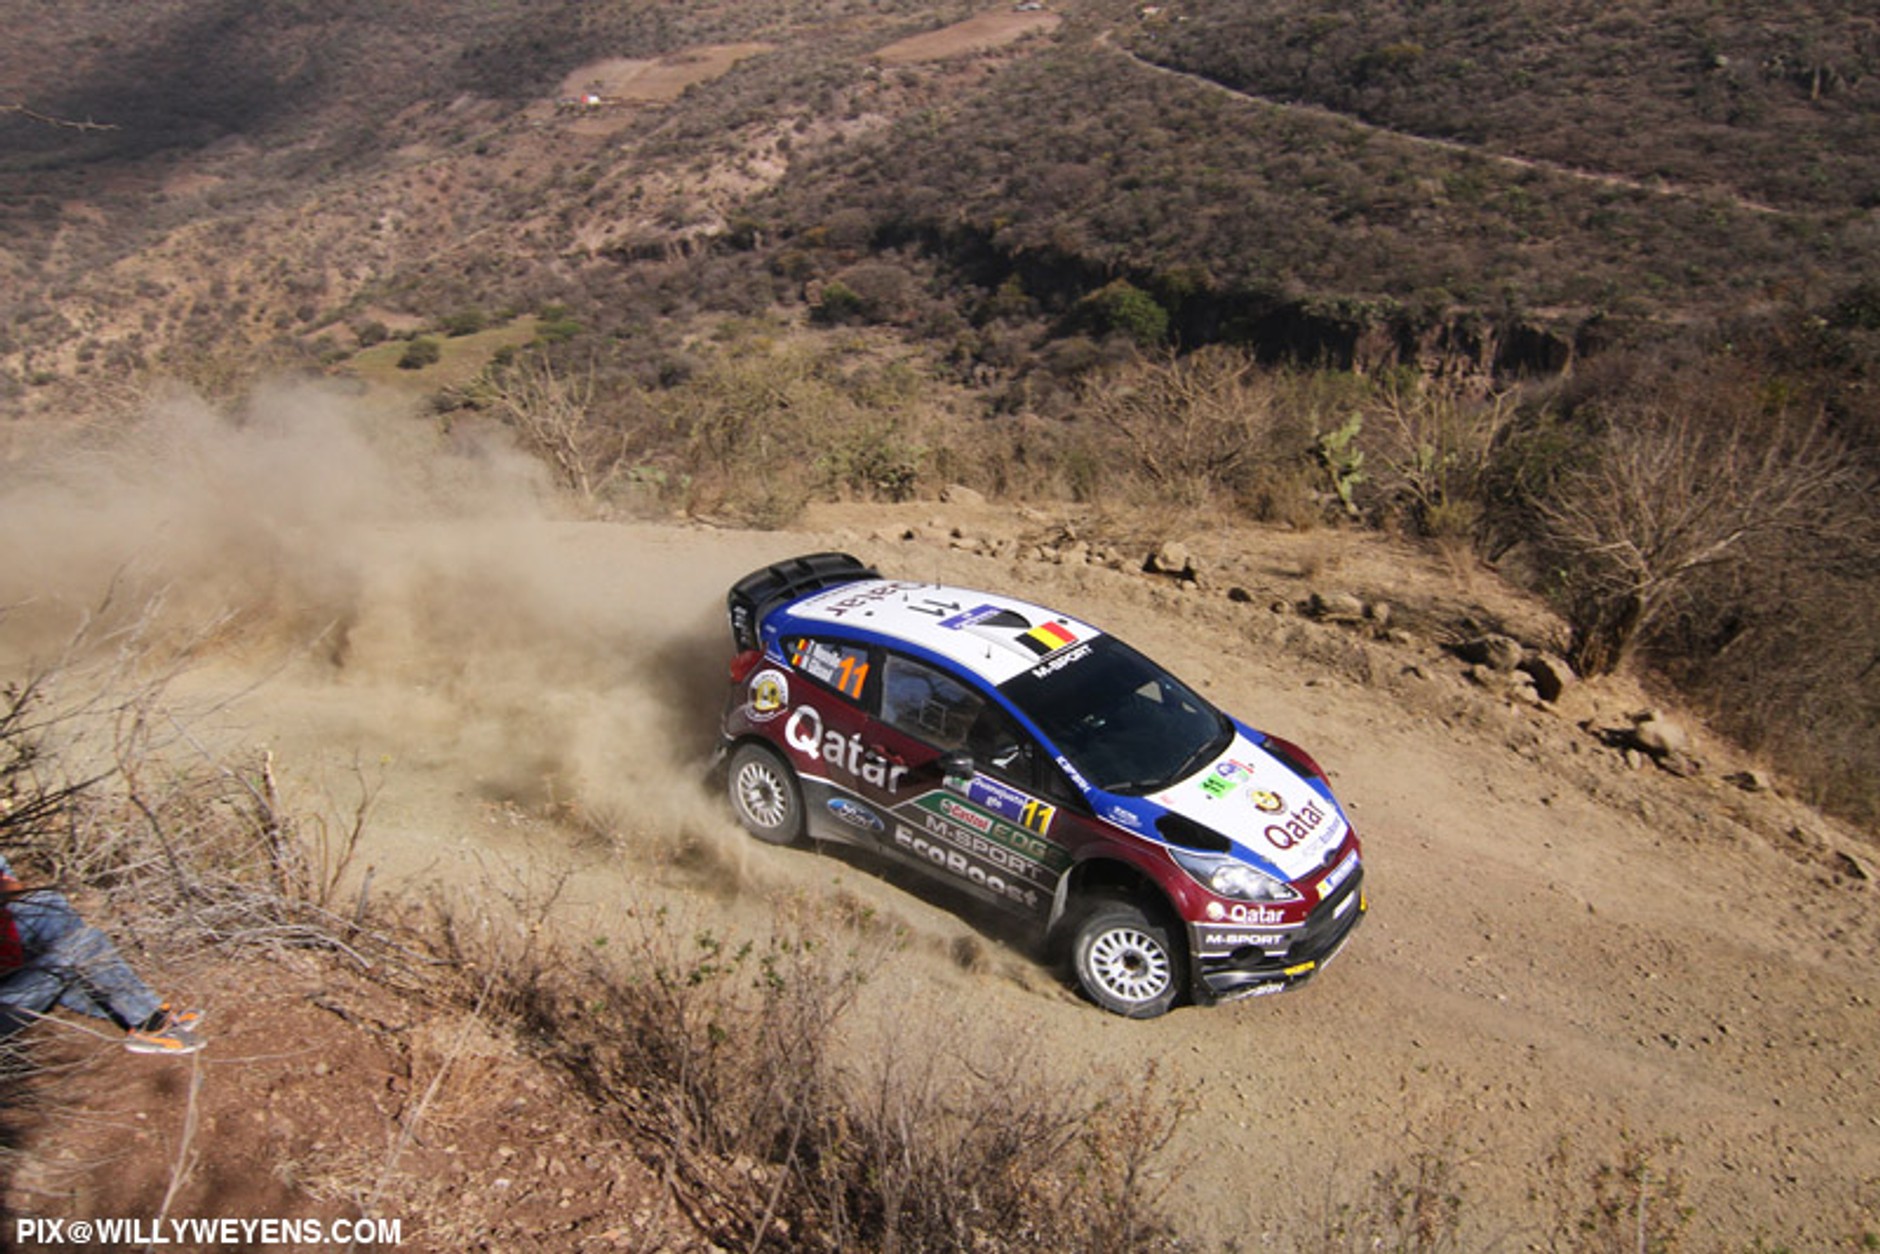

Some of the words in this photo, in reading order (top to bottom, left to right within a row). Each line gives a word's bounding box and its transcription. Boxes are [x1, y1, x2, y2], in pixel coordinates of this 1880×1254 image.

[838, 656, 870, 700] 11
[785, 704, 909, 794] Qatar
[950, 803, 990, 833] Castrol
[1023, 799, 1056, 836] 11
[1264, 799, 1326, 851] Qatar
[895, 823, 1038, 908] EcoBoost
[1231, 904, 1285, 923] Qatar
[1205, 933, 1284, 945] M-SPORT
